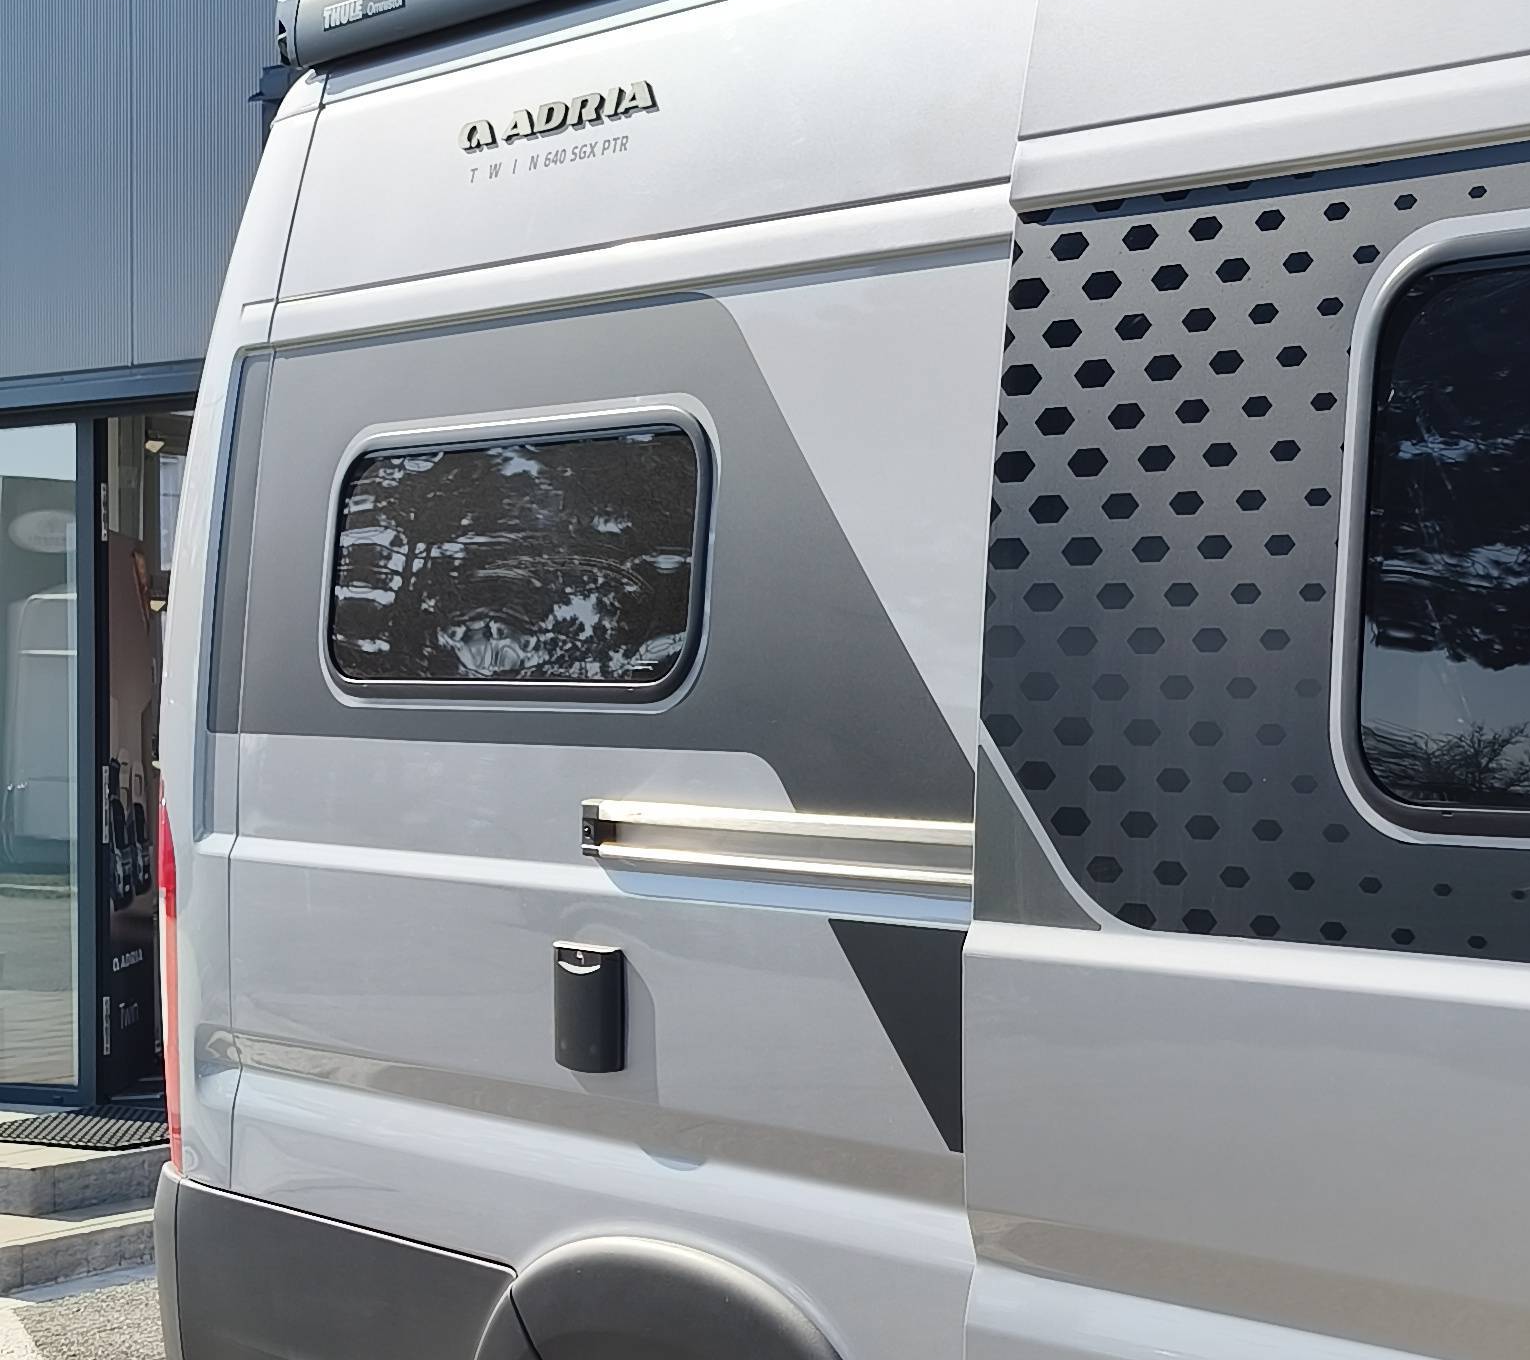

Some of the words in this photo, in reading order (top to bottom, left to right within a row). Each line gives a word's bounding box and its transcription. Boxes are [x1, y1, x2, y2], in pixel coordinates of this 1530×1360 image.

[323, 0, 363, 29] THULE
[501, 80, 659, 145] ADRIA
[543, 148, 566, 168] 640
[569, 141, 599, 163] SGX
[601, 135, 629, 156] PTR
